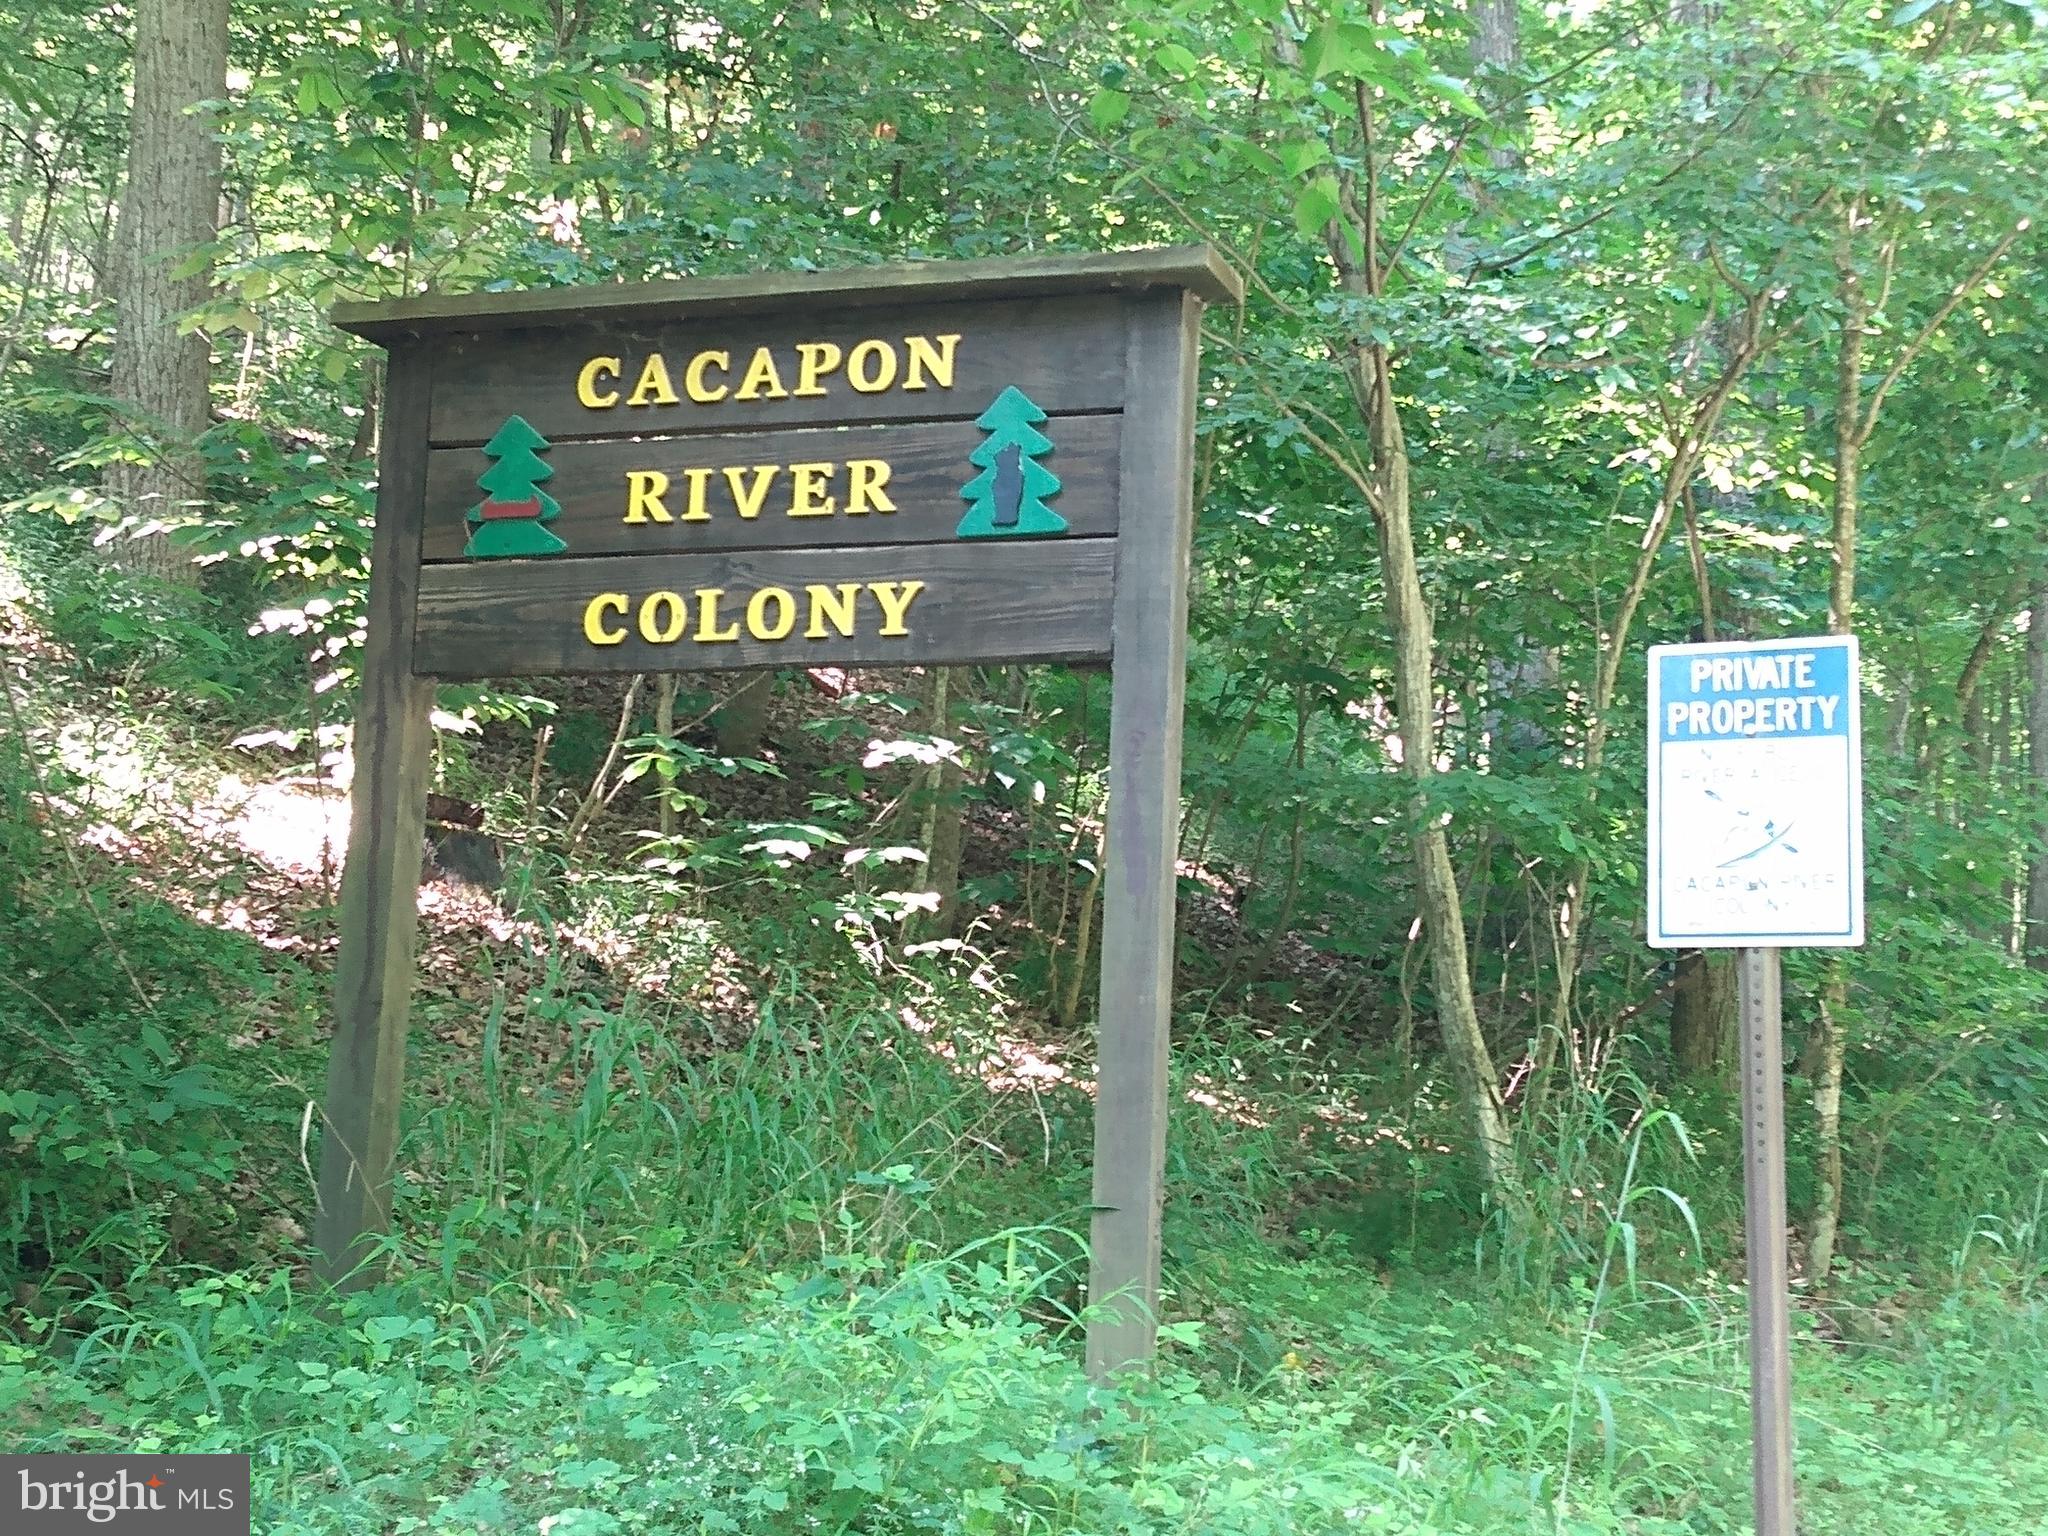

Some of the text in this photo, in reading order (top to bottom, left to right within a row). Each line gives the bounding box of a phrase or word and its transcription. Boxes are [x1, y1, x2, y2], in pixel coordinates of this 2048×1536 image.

[577, 334, 962, 409] CACAPON
[623, 459, 898, 525] RIVER
[583, 581, 925, 645] COLONY
[1690, 654, 1816, 693] PRIVATE
[1667, 695, 1839, 735] PROPERTY
